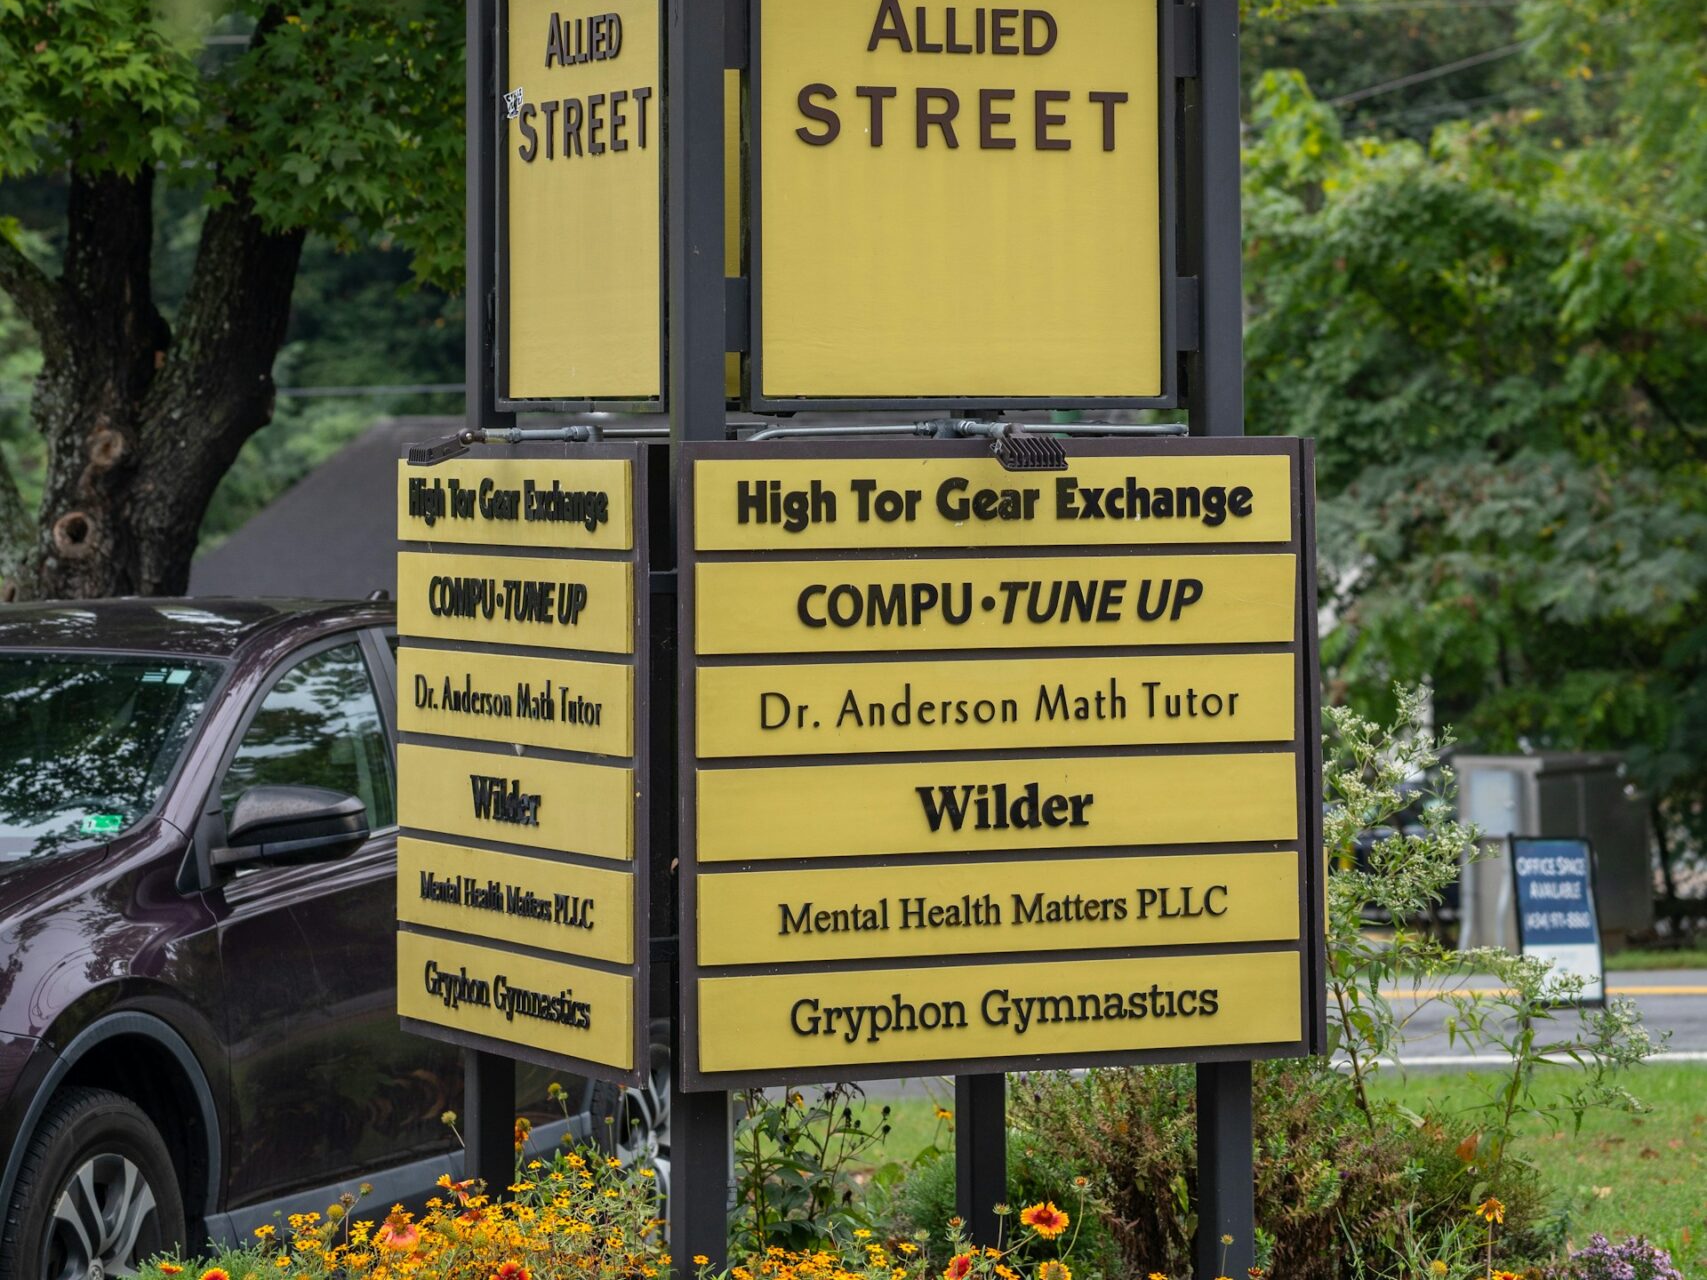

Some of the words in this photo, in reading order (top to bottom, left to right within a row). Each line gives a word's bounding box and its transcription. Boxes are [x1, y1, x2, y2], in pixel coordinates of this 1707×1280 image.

[545, 13, 622, 69] ALLIED
[518, 86, 652, 163] STREET
[796, 84, 1128, 152] STREET
[409, 478, 446, 527] High
[448, 479, 476, 519] Tor
[479, 478, 520, 521] Gear
[524, 480, 608, 533] Exchange
[738, 480, 836, 533] High
[851, 480, 921, 522] Tor
[936, 477, 1039, 522] Gear
[1056, 477, 1253, 527] Exchange
[558, 583, 587, 625] UP
[1137, 579, 1203, 622] UP
[415, 675, 438, 709] Dr.
[442, 674, 511, 717] Anderson
[517, 680, 554, 721] Math
[560, 687, 601, 726] Tutor
[761, 693, 819, 730] Dr.
[837, 684, 1017, 727] Anderson
[1036, 678, 1126, 721] Math
[1142, 682, 1238, 718] Tutor
[470, 775, 541, 827] Wilder
[915, 783, 1093, 832] Wilder
[420, 871, 461, 906] Mental
[464, 878, 504, 913] Health
[506, 885, 552, 922] Matters
[554, 894, 594, 930] PLLC
[779, 898, 889, 935] Mental
[899, 894, 1001, 929] Health
[1011, 893, 1127, 925] Matters
[1137, 886, 1227, 919] PLLC
[425, 961, 491, 1010] Gryphon
[493, 975, 590, 1030] Gymnastics
[791, 994, 968, 1044] Gryphon
[981, 984, 1218, 1034] Gymnastics
